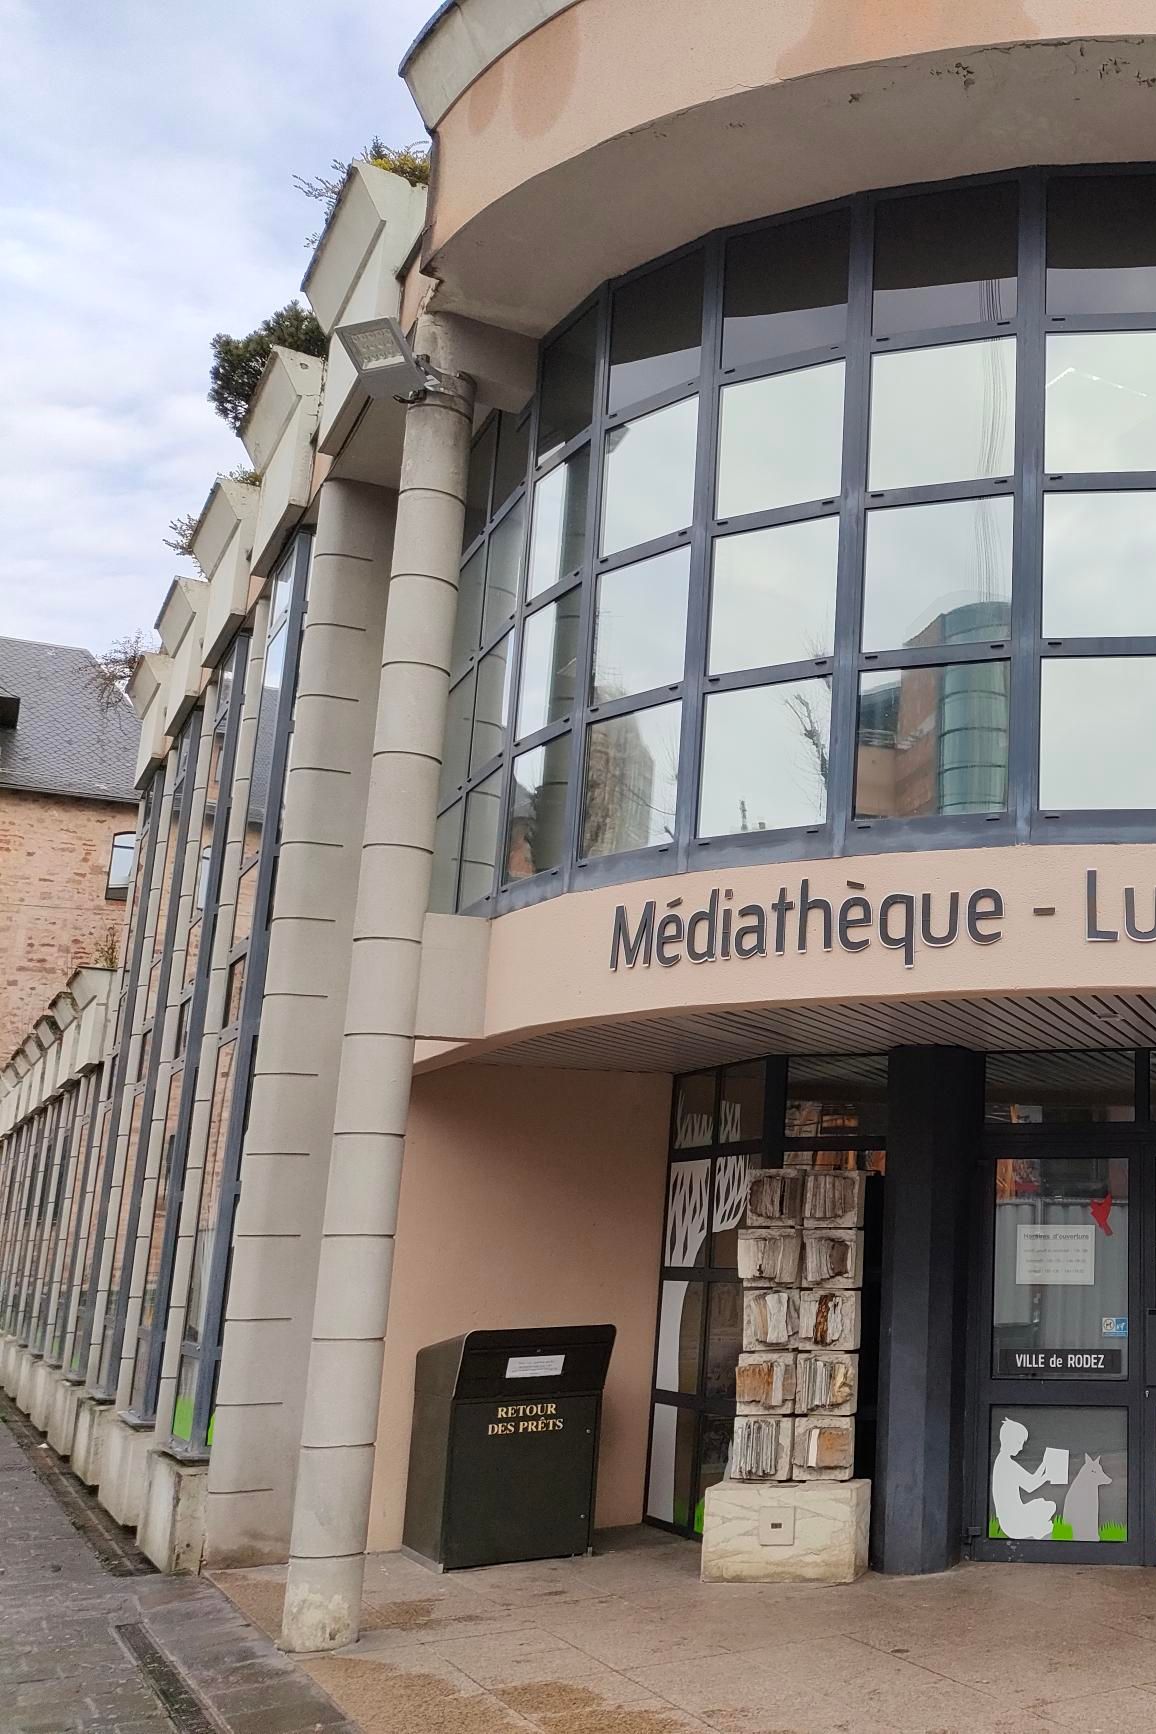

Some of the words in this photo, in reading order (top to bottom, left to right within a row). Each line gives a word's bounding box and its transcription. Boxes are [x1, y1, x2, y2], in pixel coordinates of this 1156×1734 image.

[609, 877, 1005, 971] Médiathèque
[1032, 906, 1057, 917] -
[1015, 1353, 1045, 1368] VILLE
[1049, 1353, 1063, 1368] de
[1067, 1354, 1105, 1369] RODEZ
[497, 1403, 557, 1419] RETOUR
[488, 1422, 516, 1436] DES
[518, 1416, 564, 1433] PRÊTS
